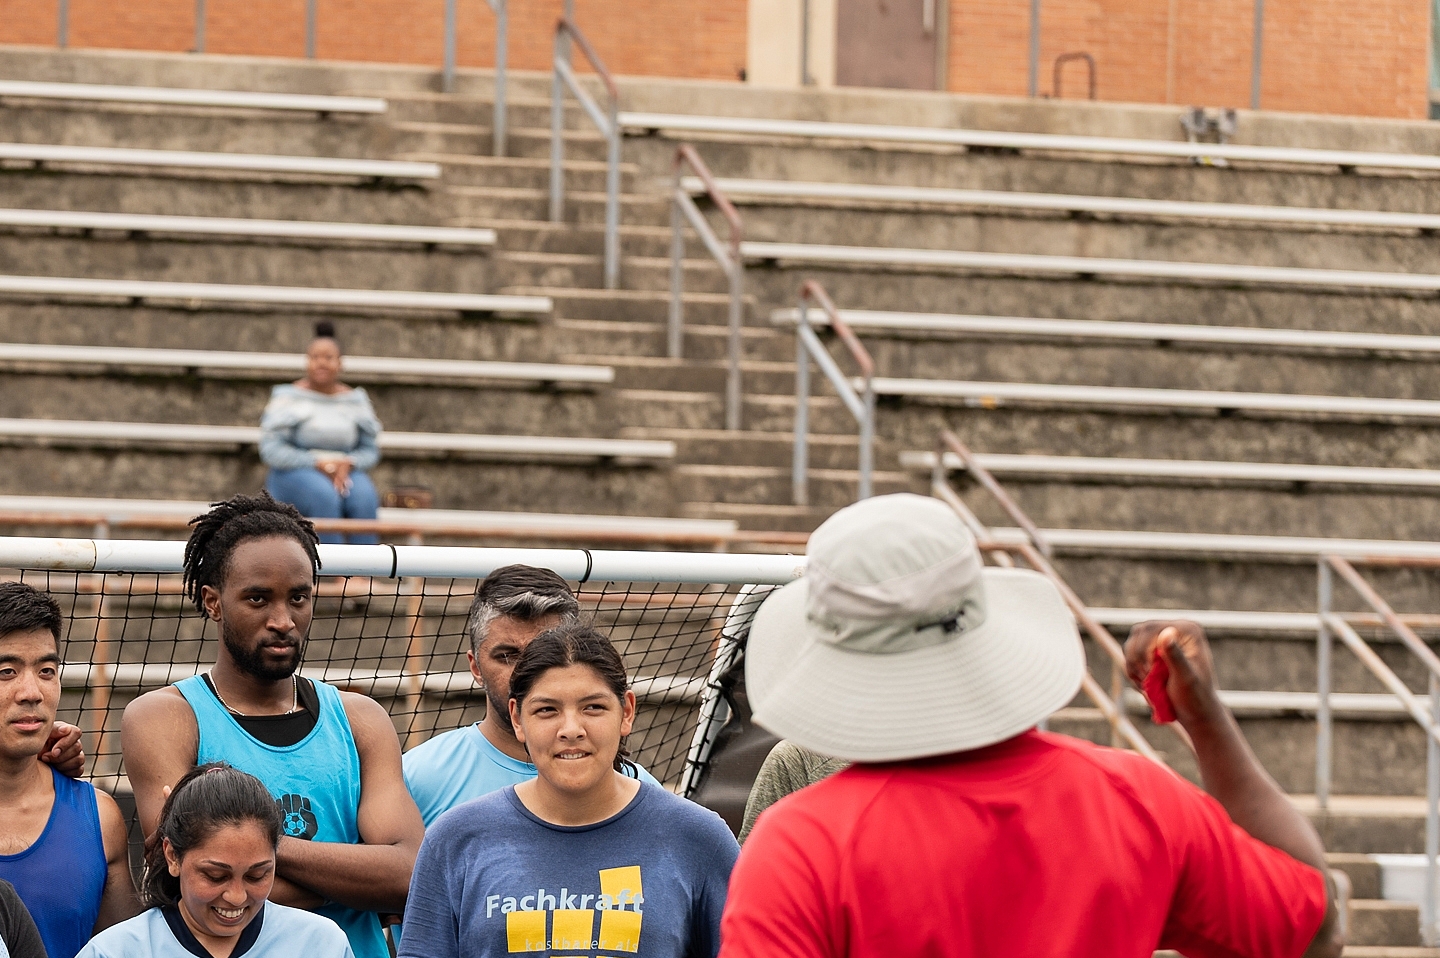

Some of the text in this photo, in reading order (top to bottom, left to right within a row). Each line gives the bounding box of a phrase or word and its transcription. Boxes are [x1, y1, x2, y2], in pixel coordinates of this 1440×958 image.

[486, 888, 644, 919] Fachkraft
[525, 937, 638, 951] kostbarer als
